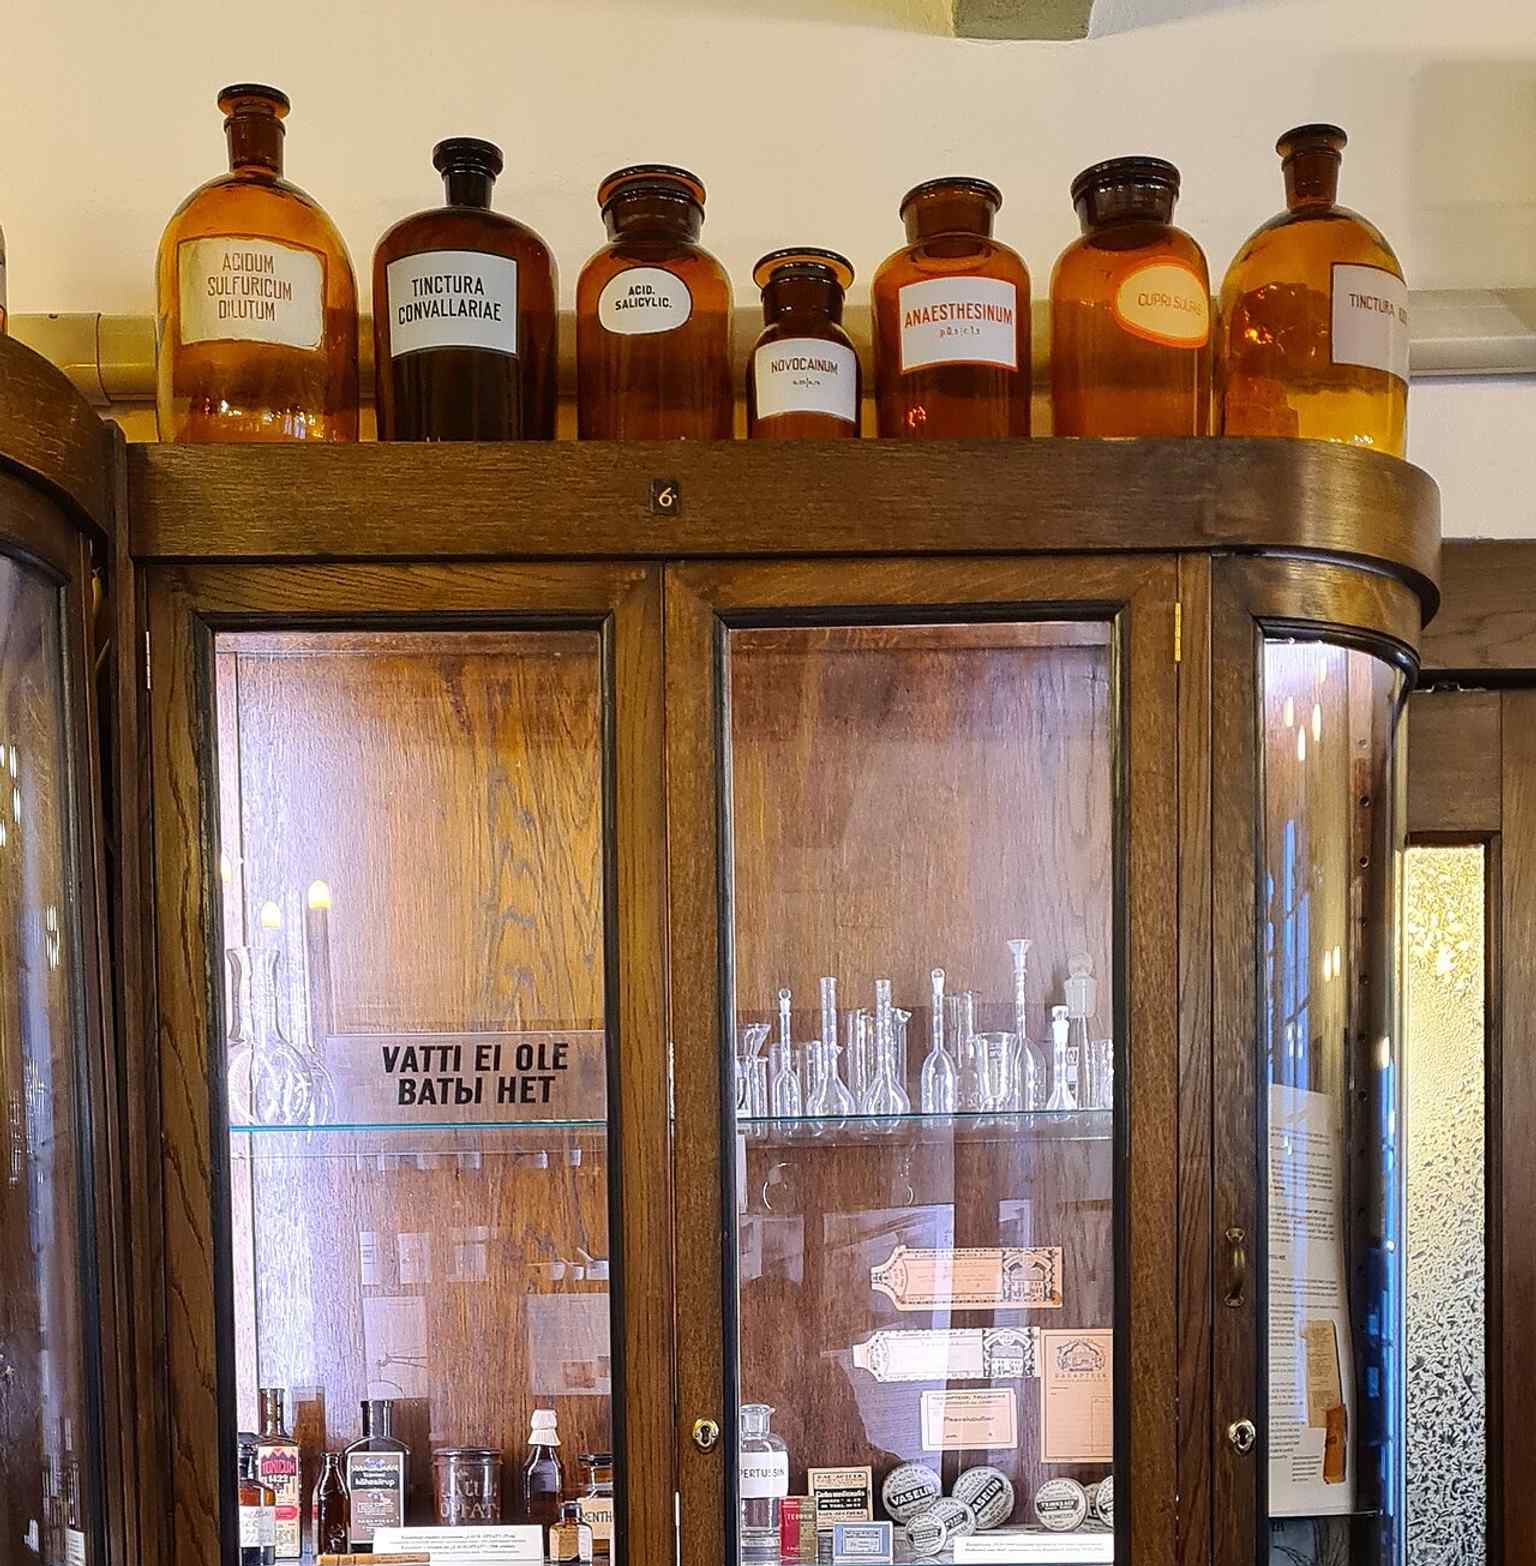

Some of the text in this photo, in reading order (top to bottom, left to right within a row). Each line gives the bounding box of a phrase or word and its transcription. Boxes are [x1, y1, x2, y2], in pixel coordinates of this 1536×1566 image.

[222, 252, 275, 274] ACIDUM
[206, 275, 293, 300] SULFURICUM
[411, 274, 485, 299] TINCTURA
[628, 284, 656, 296] ACID.
[218, 299, 277, 322] DILUTUM
[397, 298, 503, 326] CONVALLARIAE
[614, 296, 673, 312] SALICYLIC.
[1138, 292, 1172, 307] CUPRI
[1348, 293, 1396, 319] TINCTURA
[904, 303, 1014, 329] ANAESTHESINUM
[770, 357, 839, 376] NOVOCAINUM
[382, 1043, 570, 1073] VATTI EI OLE
[398, 1076, 556, 1105] ВАТЫ НЕТ
[971, 1479, 1003, 1513] ASELIN
